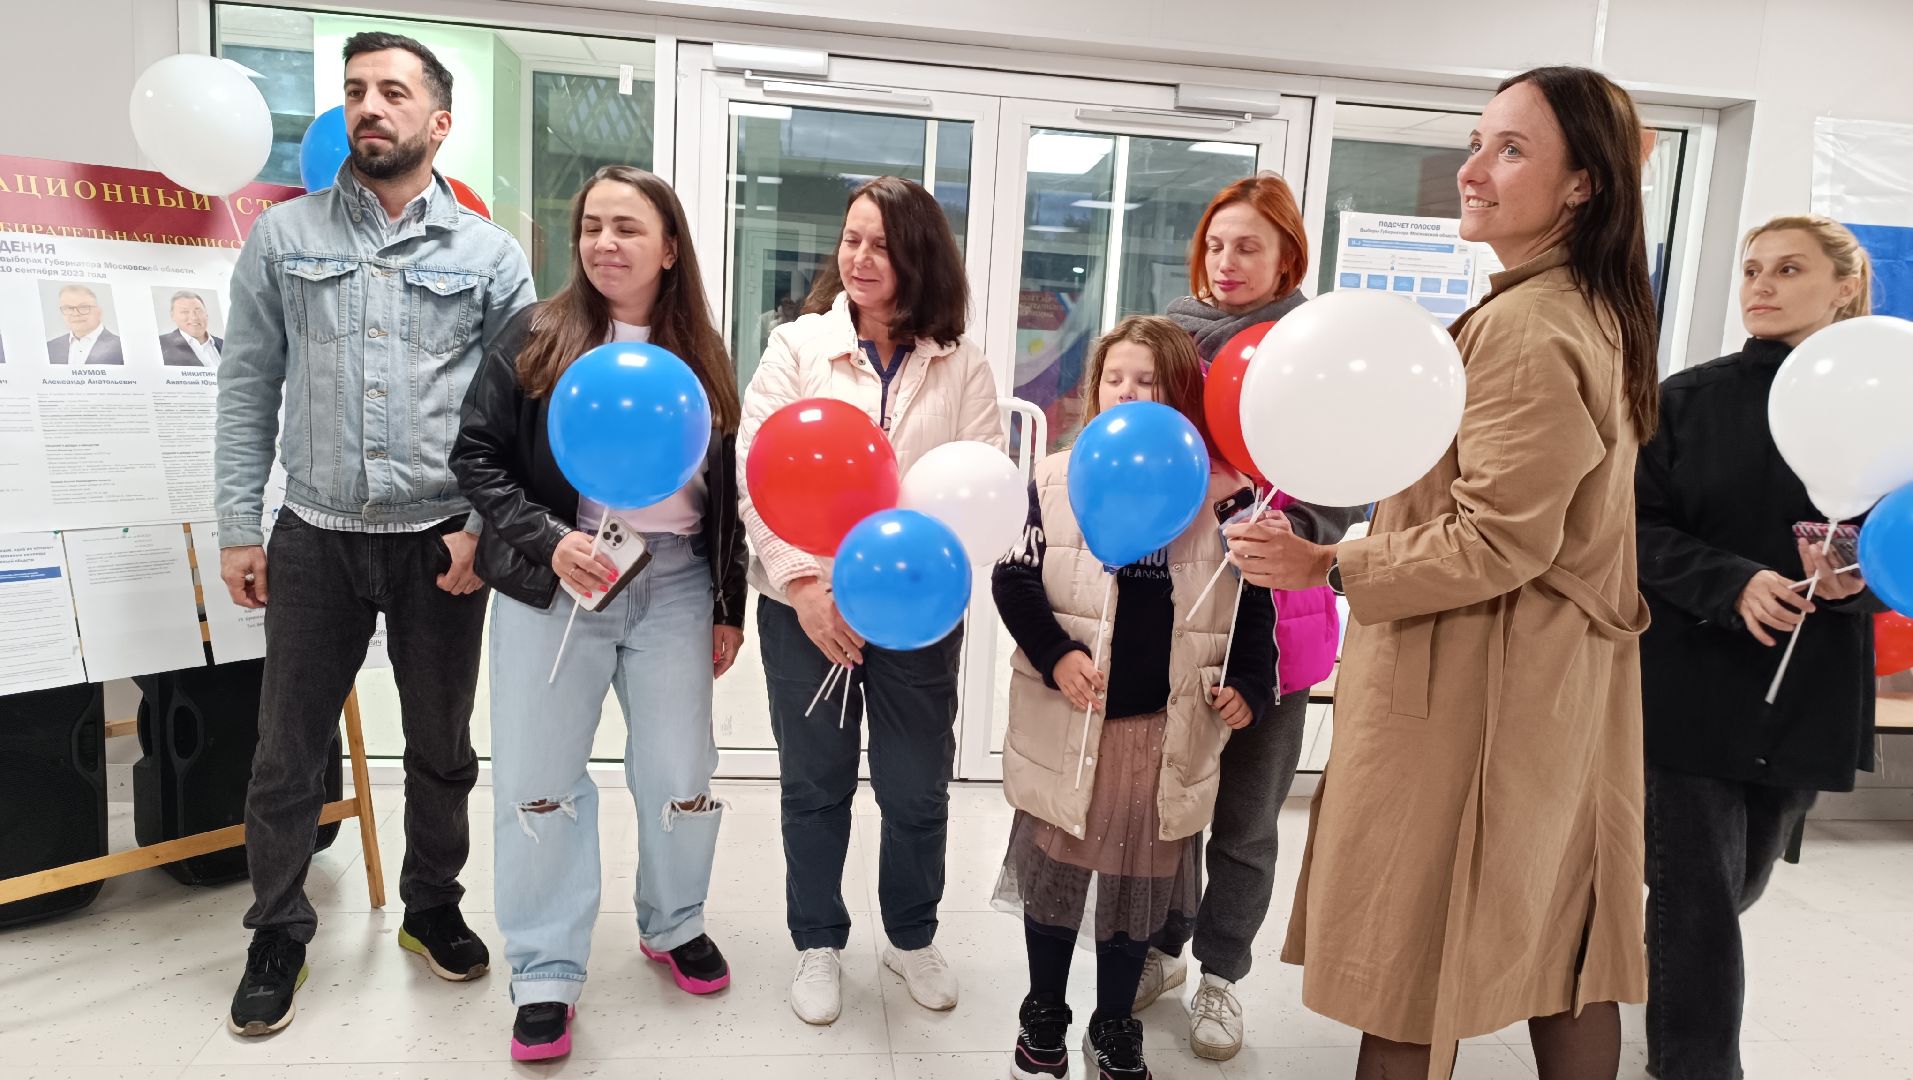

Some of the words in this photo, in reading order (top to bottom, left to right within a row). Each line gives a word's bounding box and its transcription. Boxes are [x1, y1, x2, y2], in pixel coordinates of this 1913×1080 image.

[1410, 223, 1441, 231] ГОЛОСОВ
[44, 257, 102, 270] Губернатора
[103, 261, 159, 273] Московской
[0, 265, 12, 273] 10
[15, 266, 59, 277] сентября
[60, 269, 84, 277] 2023
[88, 271, 107, 279] года
[42, 378, 86, 386] Александр
